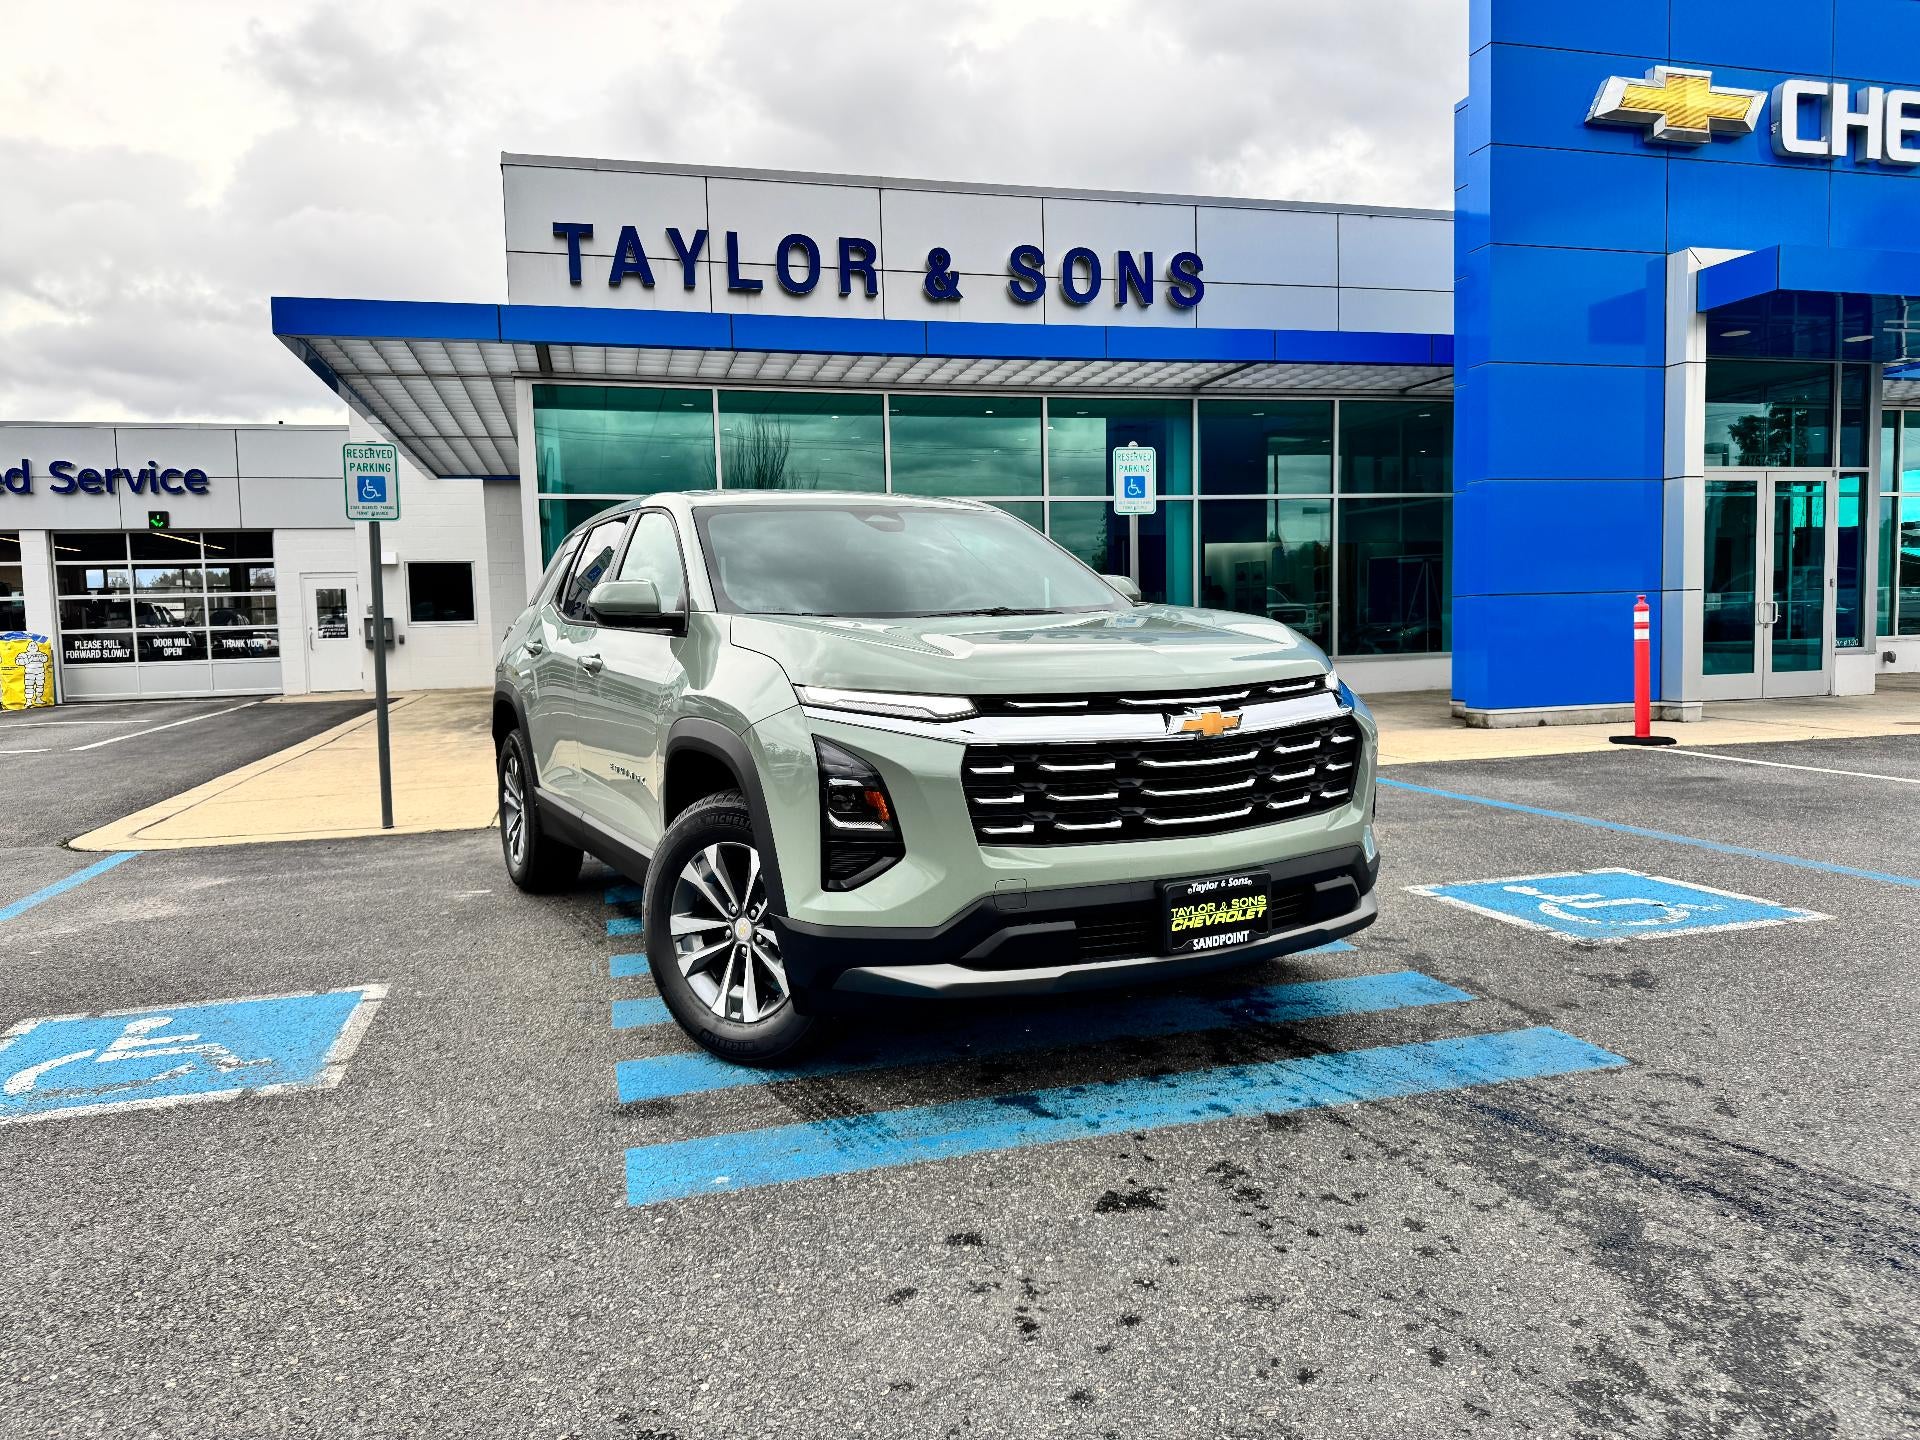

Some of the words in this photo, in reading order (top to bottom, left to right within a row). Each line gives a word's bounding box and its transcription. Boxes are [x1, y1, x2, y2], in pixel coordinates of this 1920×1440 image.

[552, 222, 879, 297] TAYLOR
[922, 246, 962, 301] &
[1006, 244, 1205, 308] SONS
[347, 449, 393, 459] RESERVED
[1117, 453, 1151, 462] RESERVED
[349, 463, 391, 473] PARKING
[1119, 464, 1150, 473] PARKING
[0, 459, 32, 494] d
[48, 460, 209, 494] Service
[75, 640, 102, 649] PLEASE
[103, 639, 121, 649] PULL
[153, 638, 173, 647] DOOR
[174, 638, 191, 647] WILL
[222, 639, 245, 649] THANK
[65, 650, 101, 659] FORWARD
[103, 649, 131, 658] SLOWLY
[163, 647, 182, 656] OPEN
[1191, 880, 1218, 894] Taylor
[1220, 879, 1226, 887] &
[1228, 877, 1249, 887] Sons
[1171, 903, 1215, 918] TAYLOR
[1219, 901, 1228, 912] &
[1231, 895, 1266, 908] SONS
[1171, 907, 1268, 931] CHEVROLET
[1193, 930, 1249, 950] SANDPOINT
